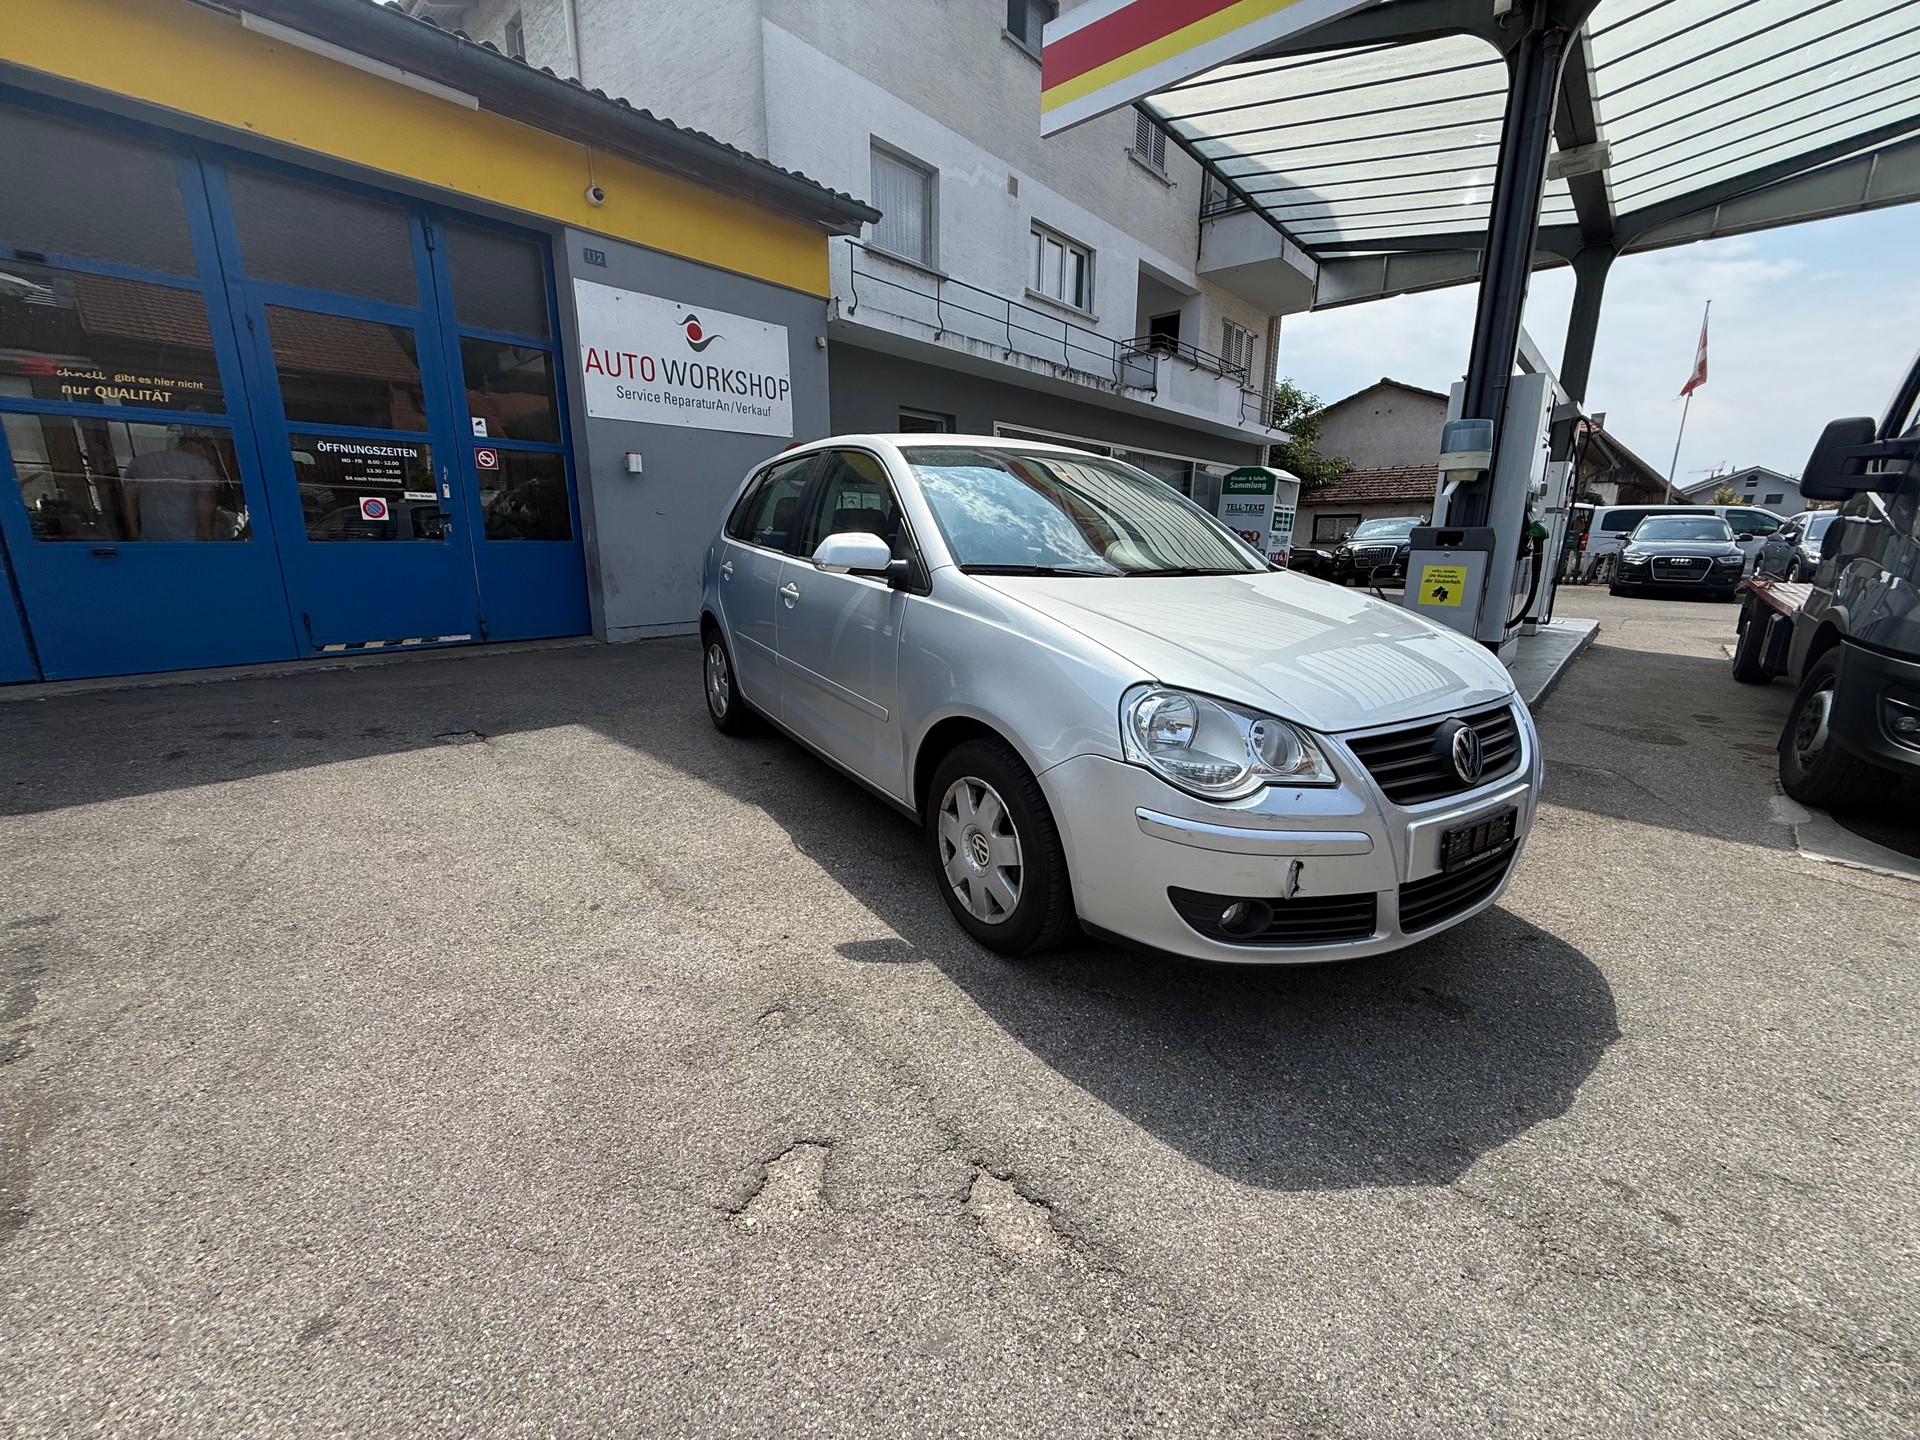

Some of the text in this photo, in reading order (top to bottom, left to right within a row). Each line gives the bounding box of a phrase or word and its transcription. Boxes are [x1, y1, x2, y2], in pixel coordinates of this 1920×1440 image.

[586, 250, 603, 263] 112
[114, 373, 136, 383] gibt
[138, 376, 151, 384] es
[154, 377, 175, 387] hier
[177, 379, 204, 389] nicht
[585, 347, 790, 401] AUTO WORKSHOP
[61, 384, 172, 402] nur QUALITÄT
[616, 385, 772, 417] Service ReparaturAn/Verkauf
[317, 441, 417, 457] ÖFFNUNGSZEITEN
[1230, 481, 1267, 490] Sammlung
